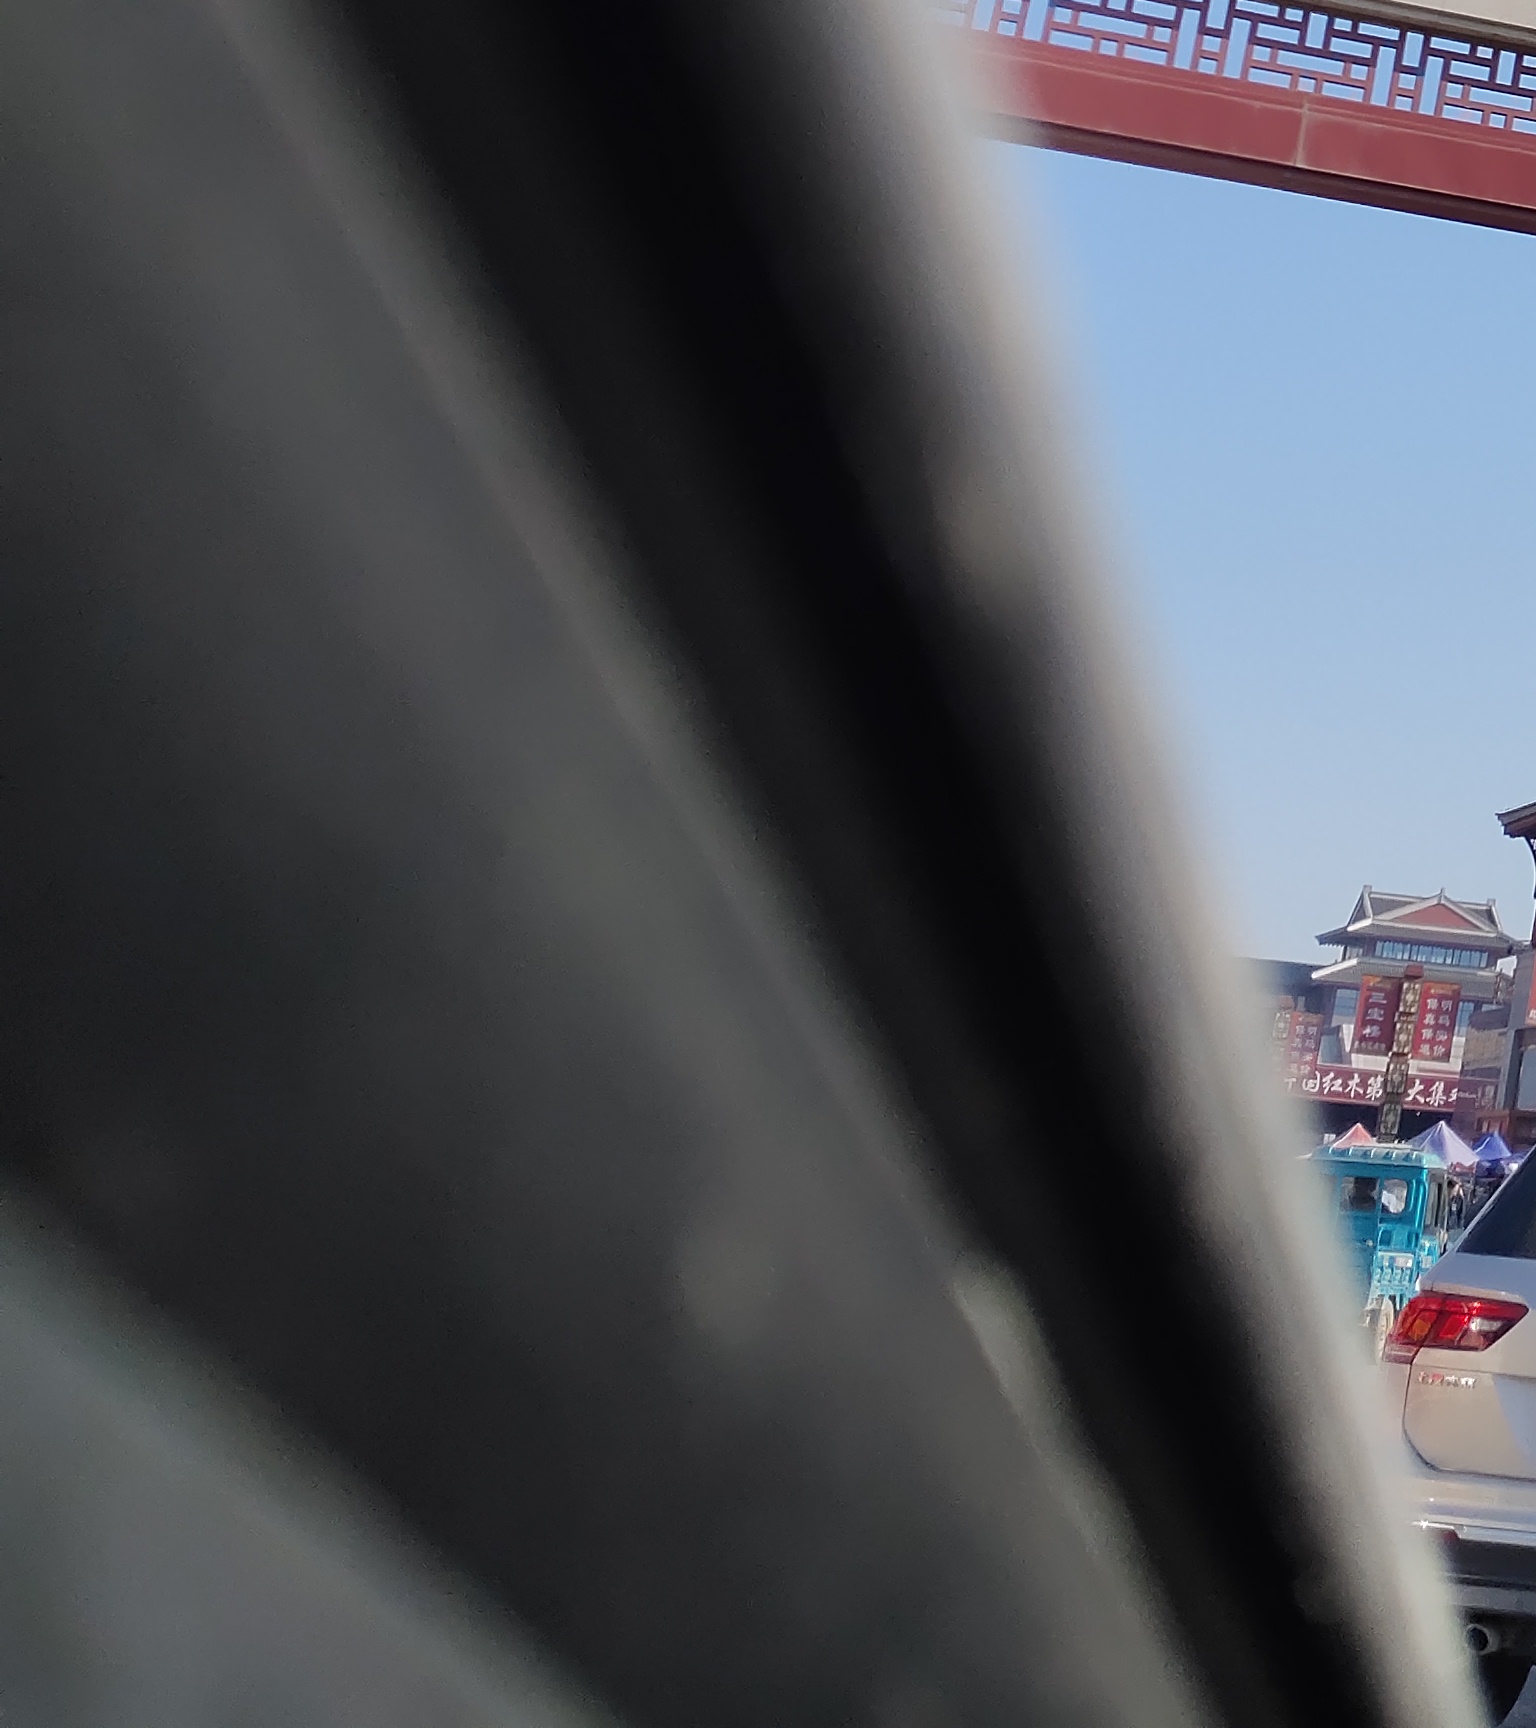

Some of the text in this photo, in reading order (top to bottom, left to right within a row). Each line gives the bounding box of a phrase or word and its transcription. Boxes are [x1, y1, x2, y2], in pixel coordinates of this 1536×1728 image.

[1284, 1070, 1459, 1107] 国红木第大集
